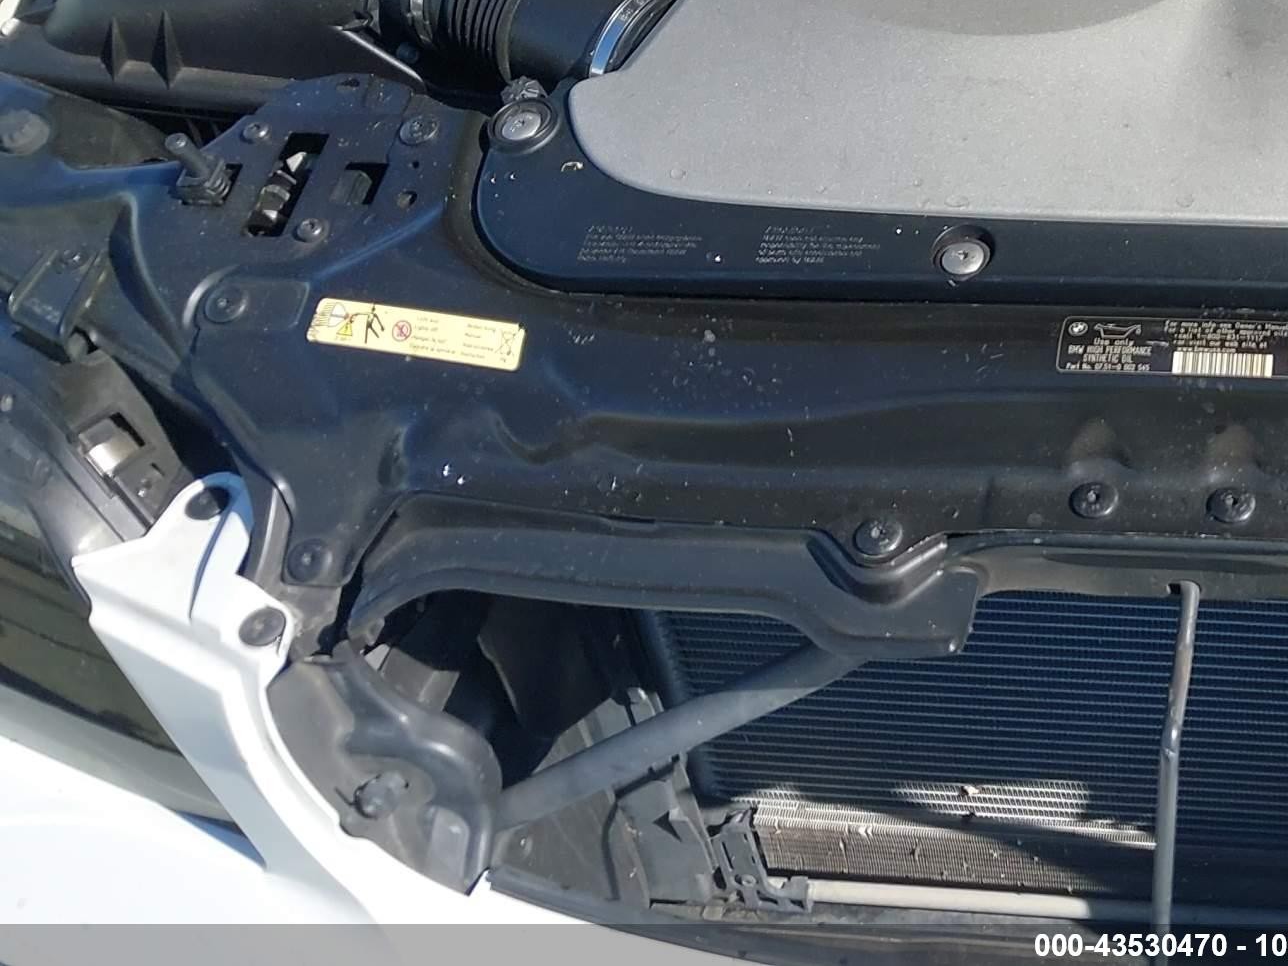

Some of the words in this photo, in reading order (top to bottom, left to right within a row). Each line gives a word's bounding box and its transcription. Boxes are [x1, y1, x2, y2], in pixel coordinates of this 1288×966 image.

[1114, 338, 1134, 346] only
[1105, 346, 1152, 356] PERFORMANCE
[1083, 354, 1119, 363] SYNTHETIC
[1122, 354, 1133, 364] OIL
